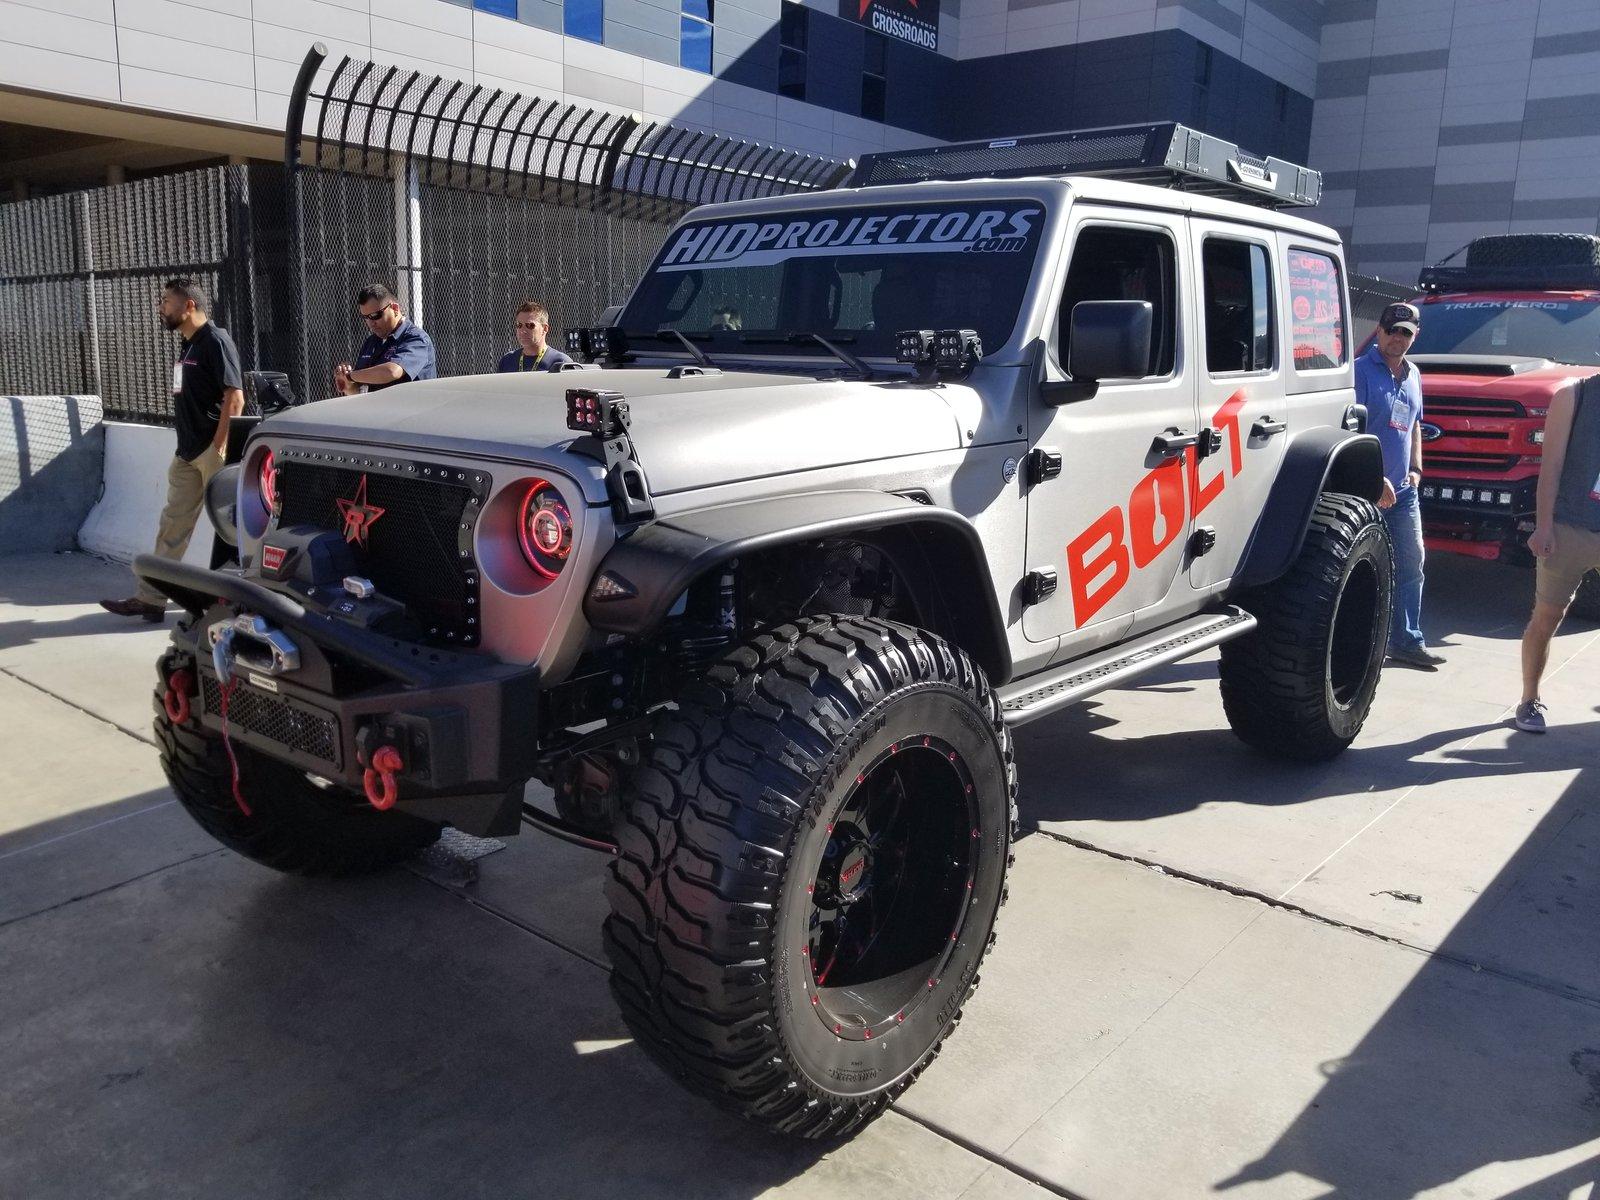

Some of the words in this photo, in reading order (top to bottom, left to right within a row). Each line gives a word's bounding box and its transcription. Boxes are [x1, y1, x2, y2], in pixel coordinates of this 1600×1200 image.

[872, 11, 936, 49] CROSSROADS
[1444, 301, 1501, 311] TRUCK
[1066, 386, 1249, 630] BOLT
